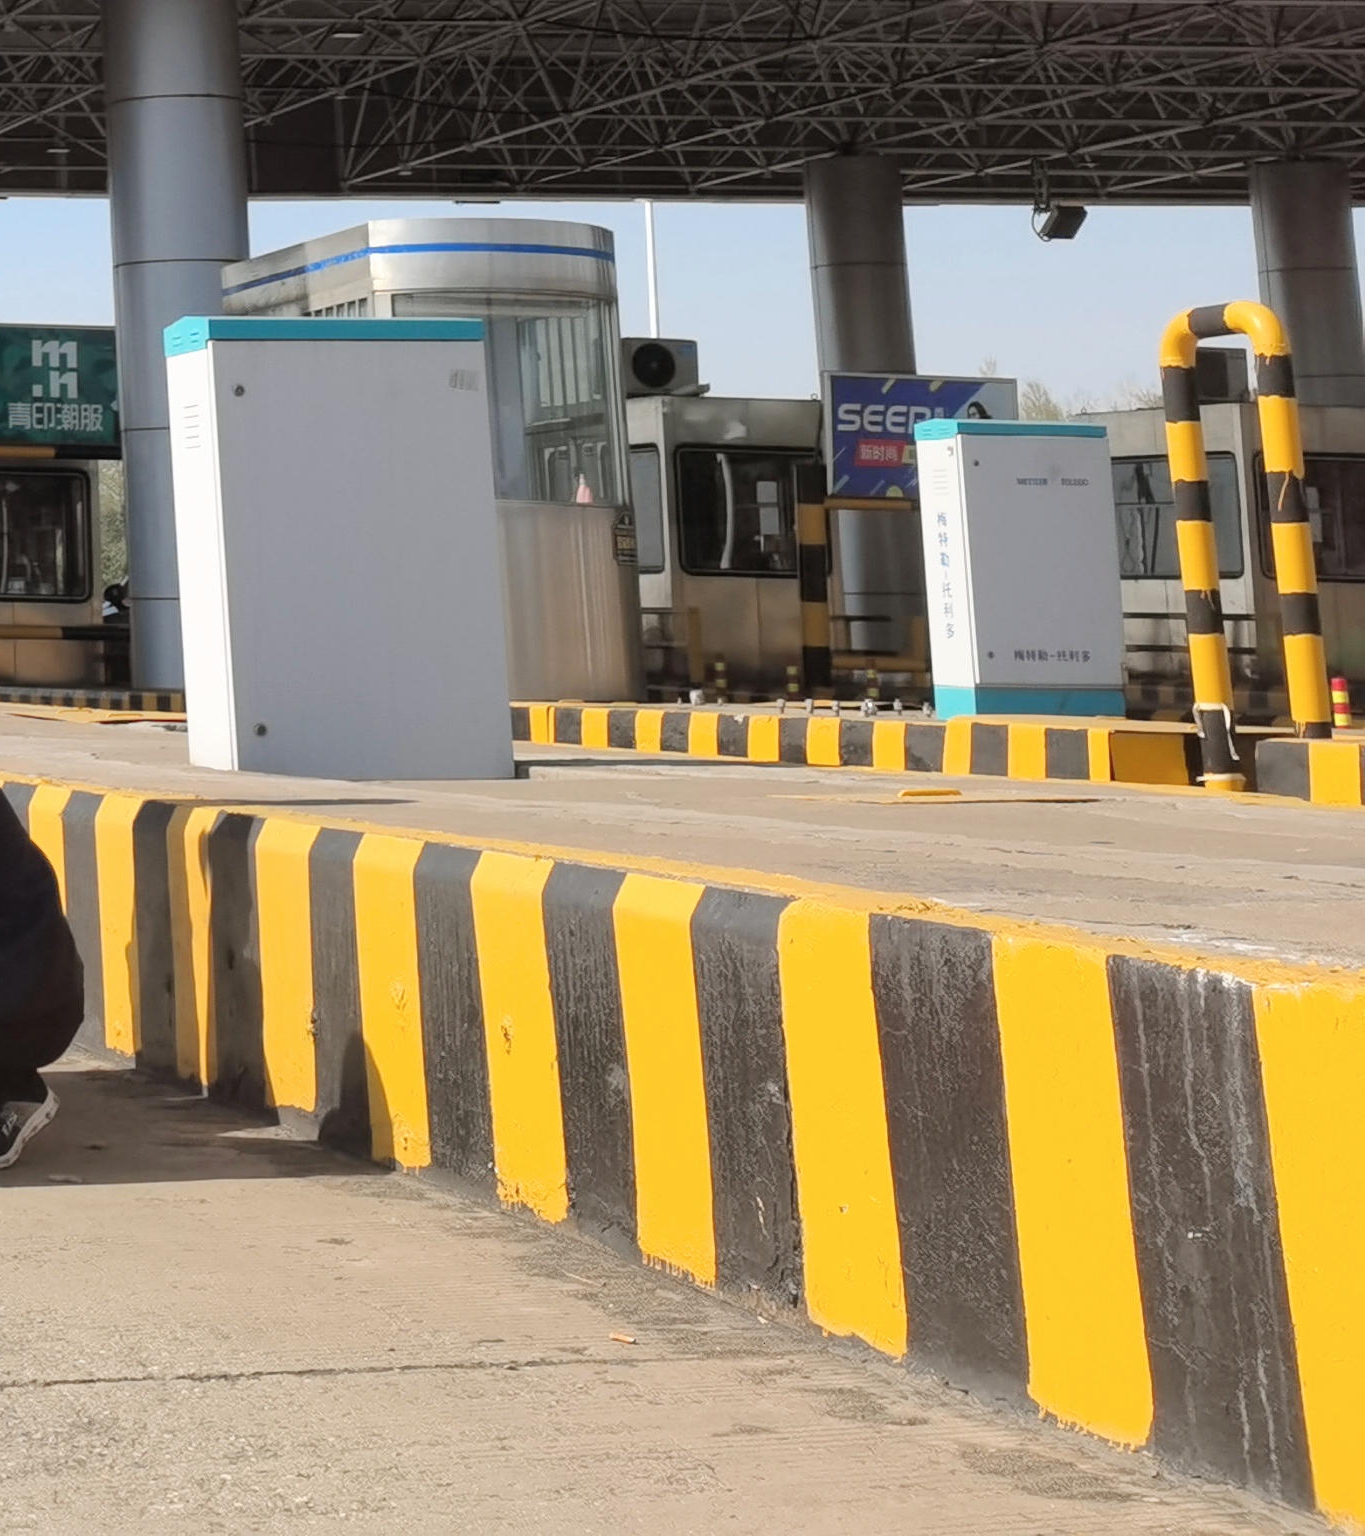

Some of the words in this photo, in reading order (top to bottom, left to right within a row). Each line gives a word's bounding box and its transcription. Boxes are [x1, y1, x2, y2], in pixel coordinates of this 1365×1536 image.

[8, 402, 104, 432] 青印潮服
[859, 444, 899, 462] 新时尚
